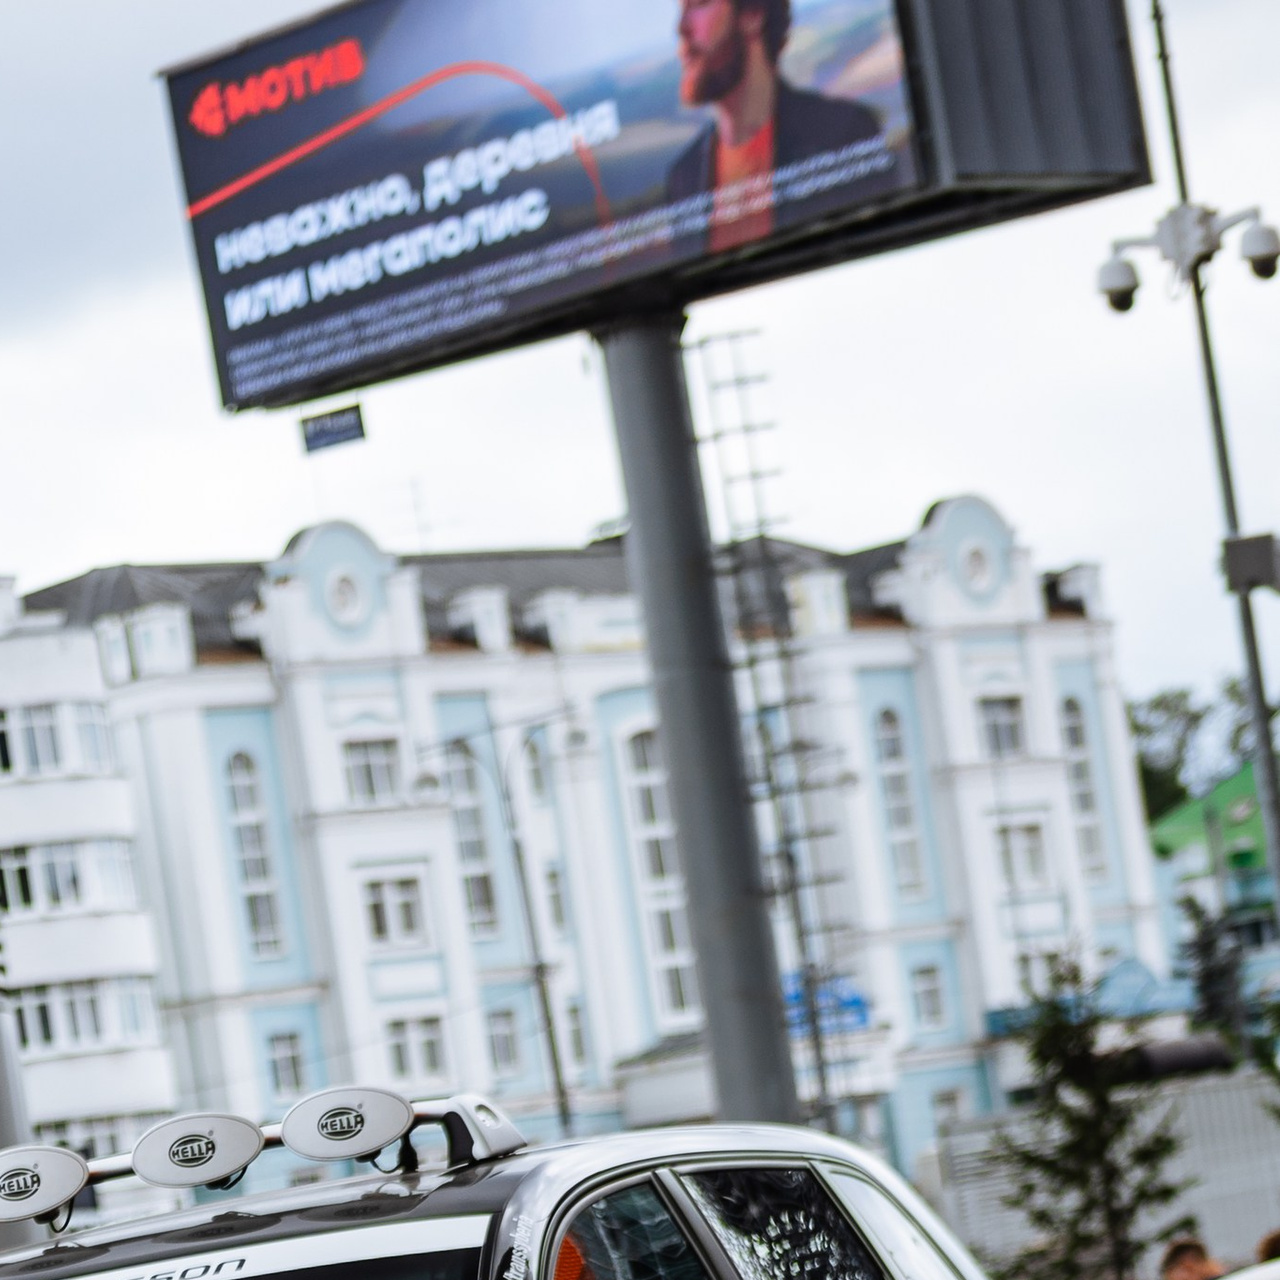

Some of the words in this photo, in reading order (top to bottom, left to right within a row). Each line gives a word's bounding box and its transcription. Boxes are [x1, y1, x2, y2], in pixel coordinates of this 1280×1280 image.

[215, 172, 421, 273] неважно,
[423, 98, 620, 212] деревня
[224, 268, 308, 330] или
[309, 187, 550, 300] мегаполис
[171, 1139, 215, 1163] HELLA
[319, 1110, 364, 1135] HELLA
